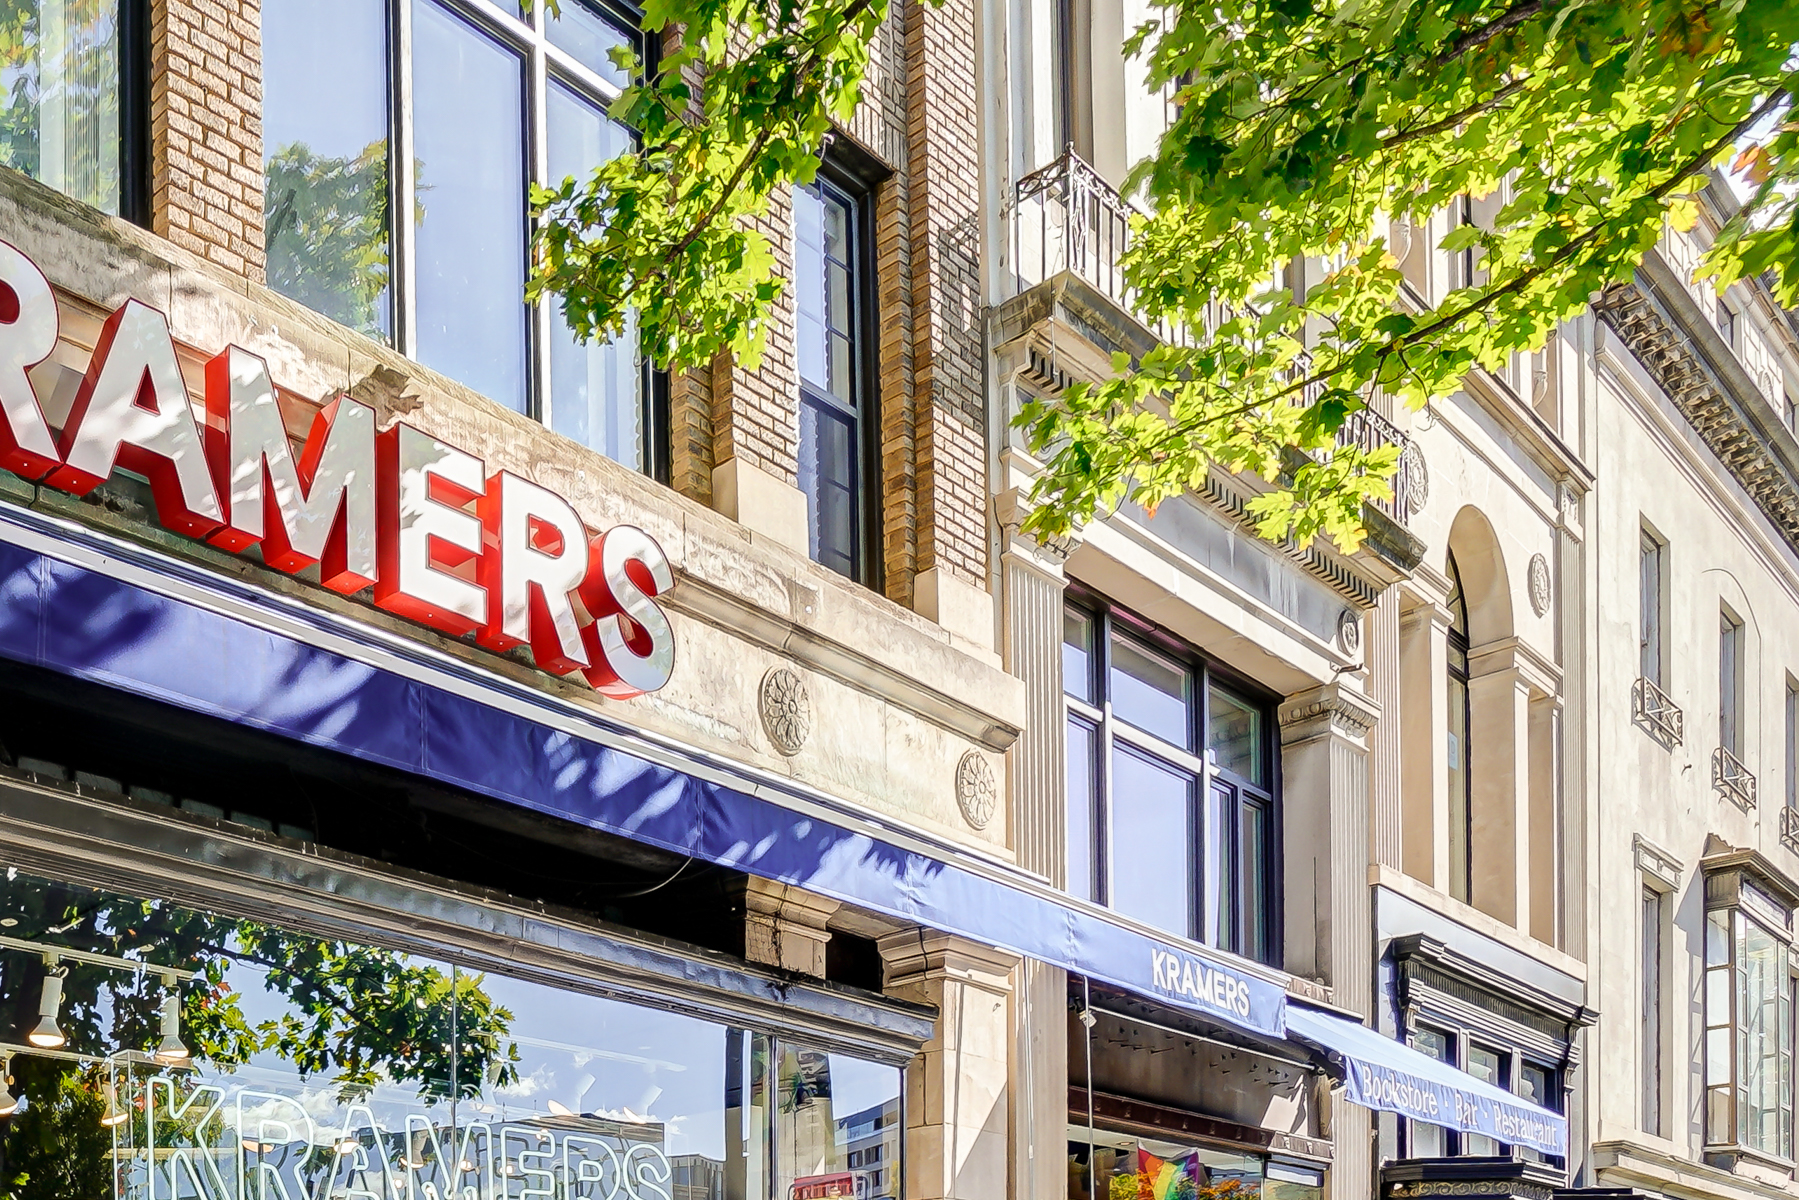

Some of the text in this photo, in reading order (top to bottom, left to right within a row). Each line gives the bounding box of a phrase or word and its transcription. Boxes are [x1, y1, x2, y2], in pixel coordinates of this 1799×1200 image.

[1151, 948, 1250, 1017] KRAMERS
[1362, 1065, 1558, 1147] Bookstore Bar Restaurant
